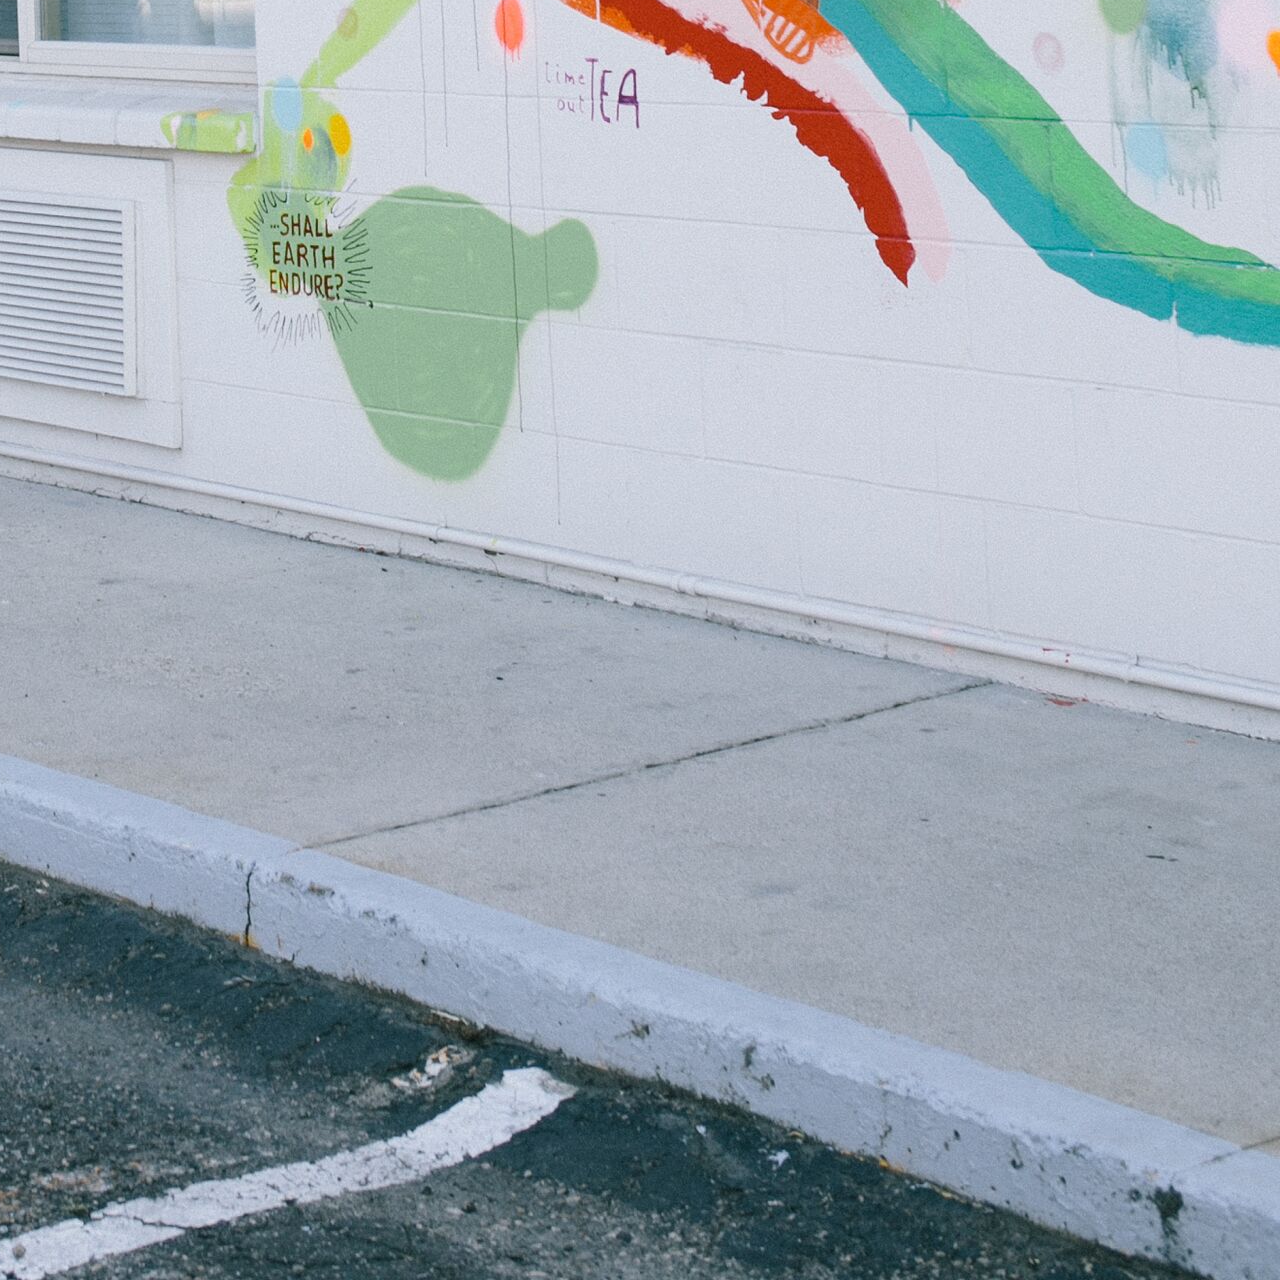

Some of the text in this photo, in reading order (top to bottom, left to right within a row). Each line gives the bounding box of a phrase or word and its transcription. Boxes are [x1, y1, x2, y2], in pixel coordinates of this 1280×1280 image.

[557, 95, 584, 113] out
[585, 58, 639, 129] TEA
[272, 240, 335, 270] EARTH
[269, 269, 344, 301] ENDURE?
